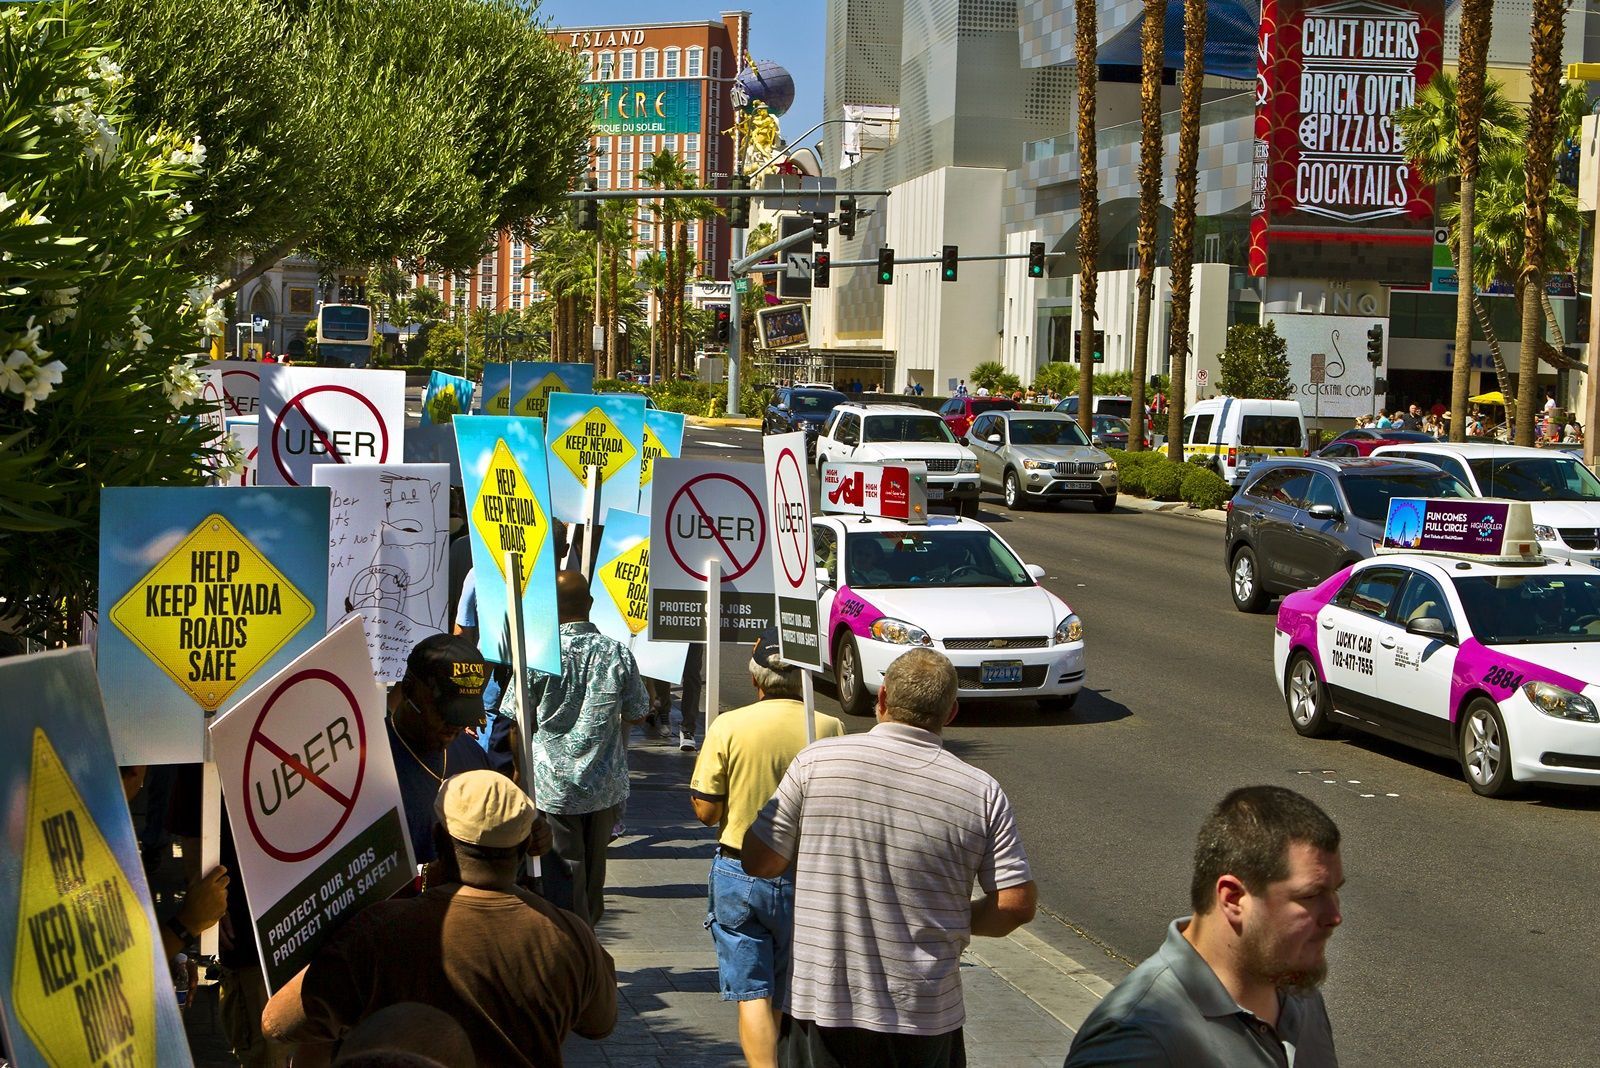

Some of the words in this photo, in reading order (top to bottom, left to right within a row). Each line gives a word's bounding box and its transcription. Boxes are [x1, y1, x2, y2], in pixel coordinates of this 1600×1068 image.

[569, 30, 645, 48] ISLAND
[1302, 18, 1359, 57] CRAFT
[1363, 20, 1420, 59] BEERS
[1300, 73, 1359, 115] BRICK
[1364, 75, 1416, 116] OVEN
[622, 124, 634, 132] DU
[636, 122, 665, 132] SOLEIL
[1319, 115, 1391, 153] PIZZAS
[1296, 162, 1409, 207] COCKTAILS
[1329, 281, 1351, 289] THE
[1302, 383, 1342, 395] COCKTAIL
[497, 397, 509, 409] KEE
[526, 398, 545, 411] KEEP
[585, 422, 606, 437] HELP
[285, 428, 377, 458] UBER
[566, 435, 588, 450] KEEP
[590, 437, 623, 453] NEVADA
[643, 446, 662, 460] VADA
[579, 450, 609, 466] ROADS
[496, 468, 516, 496] HELP
[824, 476, 840, 484] HEELS
[865, 483, 878, 491] HIGH
[865, 490, 878, 498] TECH
[483, 494, 504, 522] KEEP
[504, 497, 537, 527] NEVADA
[778, 502, 805, 533] UBER
[1426, 511, 1441, 521] FUN
[1442, 512, 1468, 522] COMES
[499, 523, 526, 554] ROADS
[677, 513, 755, 542] UBER
[1425, 522, 1442, 531] FULL
[1443, 523, 1469, 533] CIRCLE
[1470, 522, 1482, 530] HIGH
[1483, 522, 1503, 530] ROLLER
[190, 551, 240, 583] HELP
[614, 560, 641, 582] KEEP
[146, 584, 197, 617] KEEP
[204, 583, 282, 616] NEVADA
[626, 581, 648, 603] ROA
[660, 601, 702, 613] PROTECT
[727, 604, 752, 615] JOBS
[841, 599, 865, 618] 2509
[179, 616, 248, 650] ROADS
[660, 615, 702, 627] PROTECT
[733, 618, 769, 629] SAFETY
[1336, 630, 1357, 650] LUCKY
[1358, 635, 1373, 654] CAB
[188, 649, 237, 682] SAFE
[1332, 650, 1374, 676] 702-477-7555
[1482, 665, 1525, 693] 2884
[255, 716, 355, 817] UBER
[42, 809, 87, 898] HELP
[268, 892, 317, 946] PROTECT
[319, 872, 344, 902] OUR
[347, 847, 376, 881] JOBS
[272, 914, 321, 967] PROTECT
[323, 887, 356, 921] YOUR
[357, 850, 399, 896] SAFETY
[28, 902, 79, 998] KEEP
[71, 875, 136, 973] NEVADA
[74, 962, 136, 1064] ROADS
